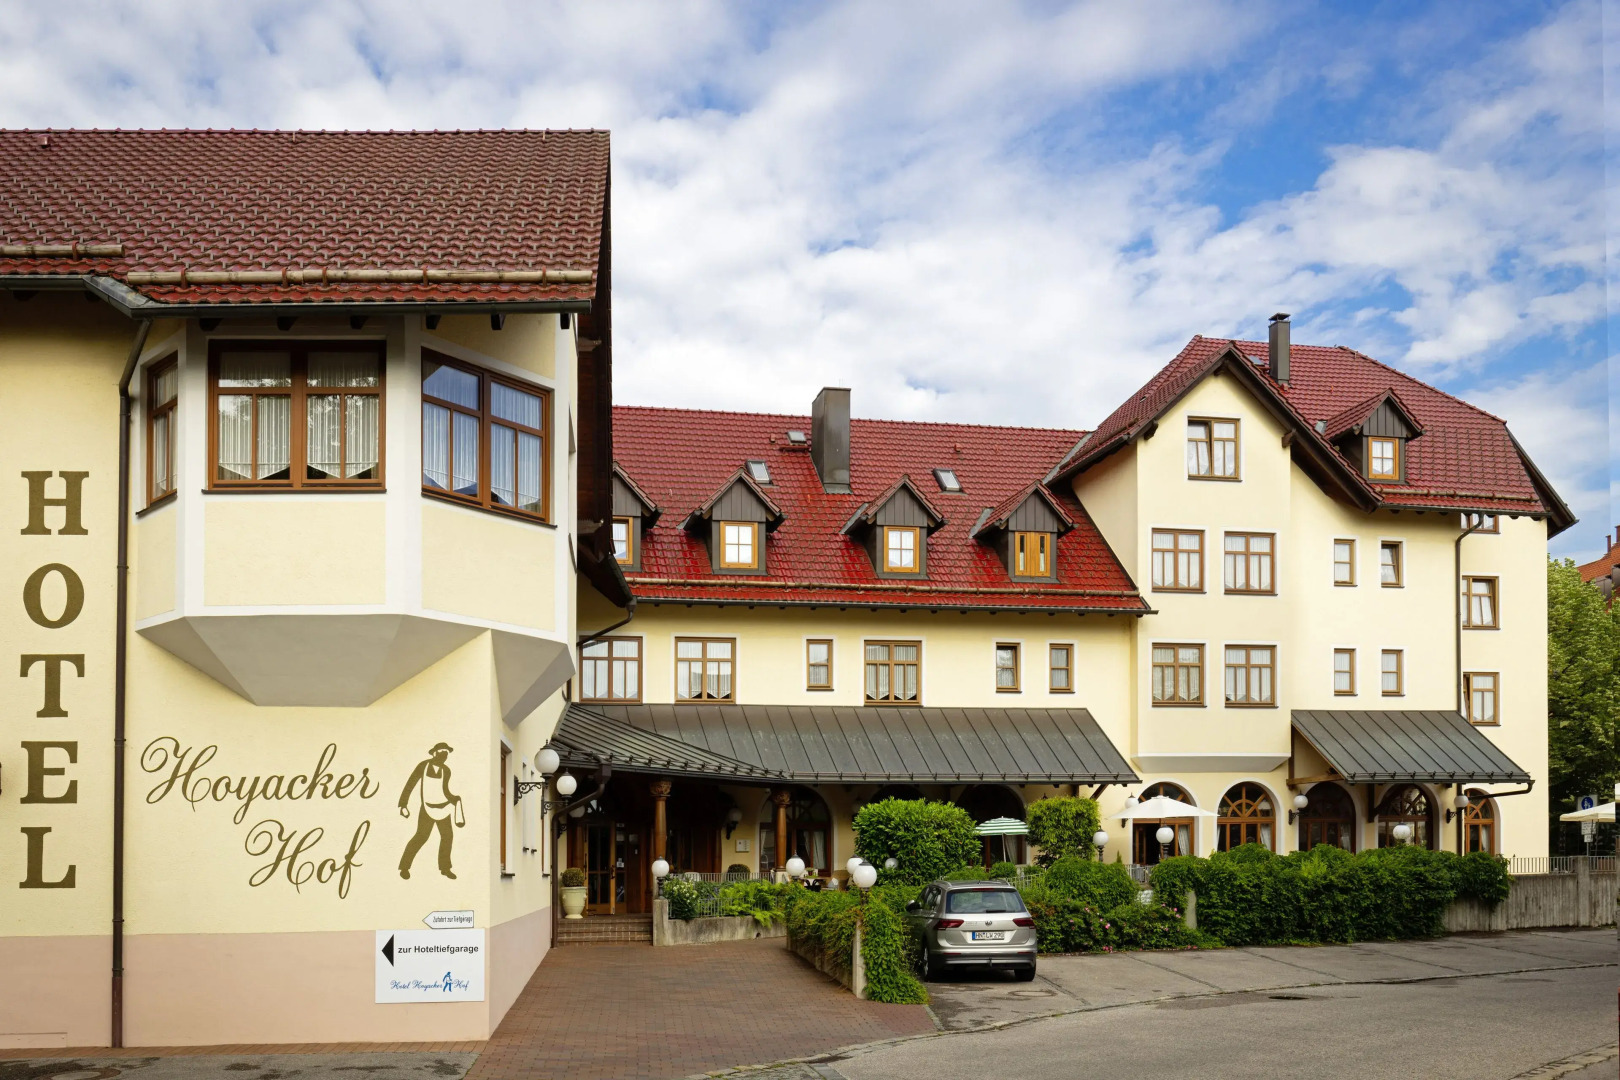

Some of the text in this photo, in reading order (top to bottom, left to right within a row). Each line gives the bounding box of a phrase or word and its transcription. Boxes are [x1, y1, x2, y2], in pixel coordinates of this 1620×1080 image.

[19, 471, 90, 889] HOTEL
[140, 736, 380, 825] Hoyacker
[244, 819, 371, 900] Hof
[390, 980, 410, 990] Hotel
[453, 979, 469, 991] Hof
[414, 945, 479, 954] Hoteltiefgarage
